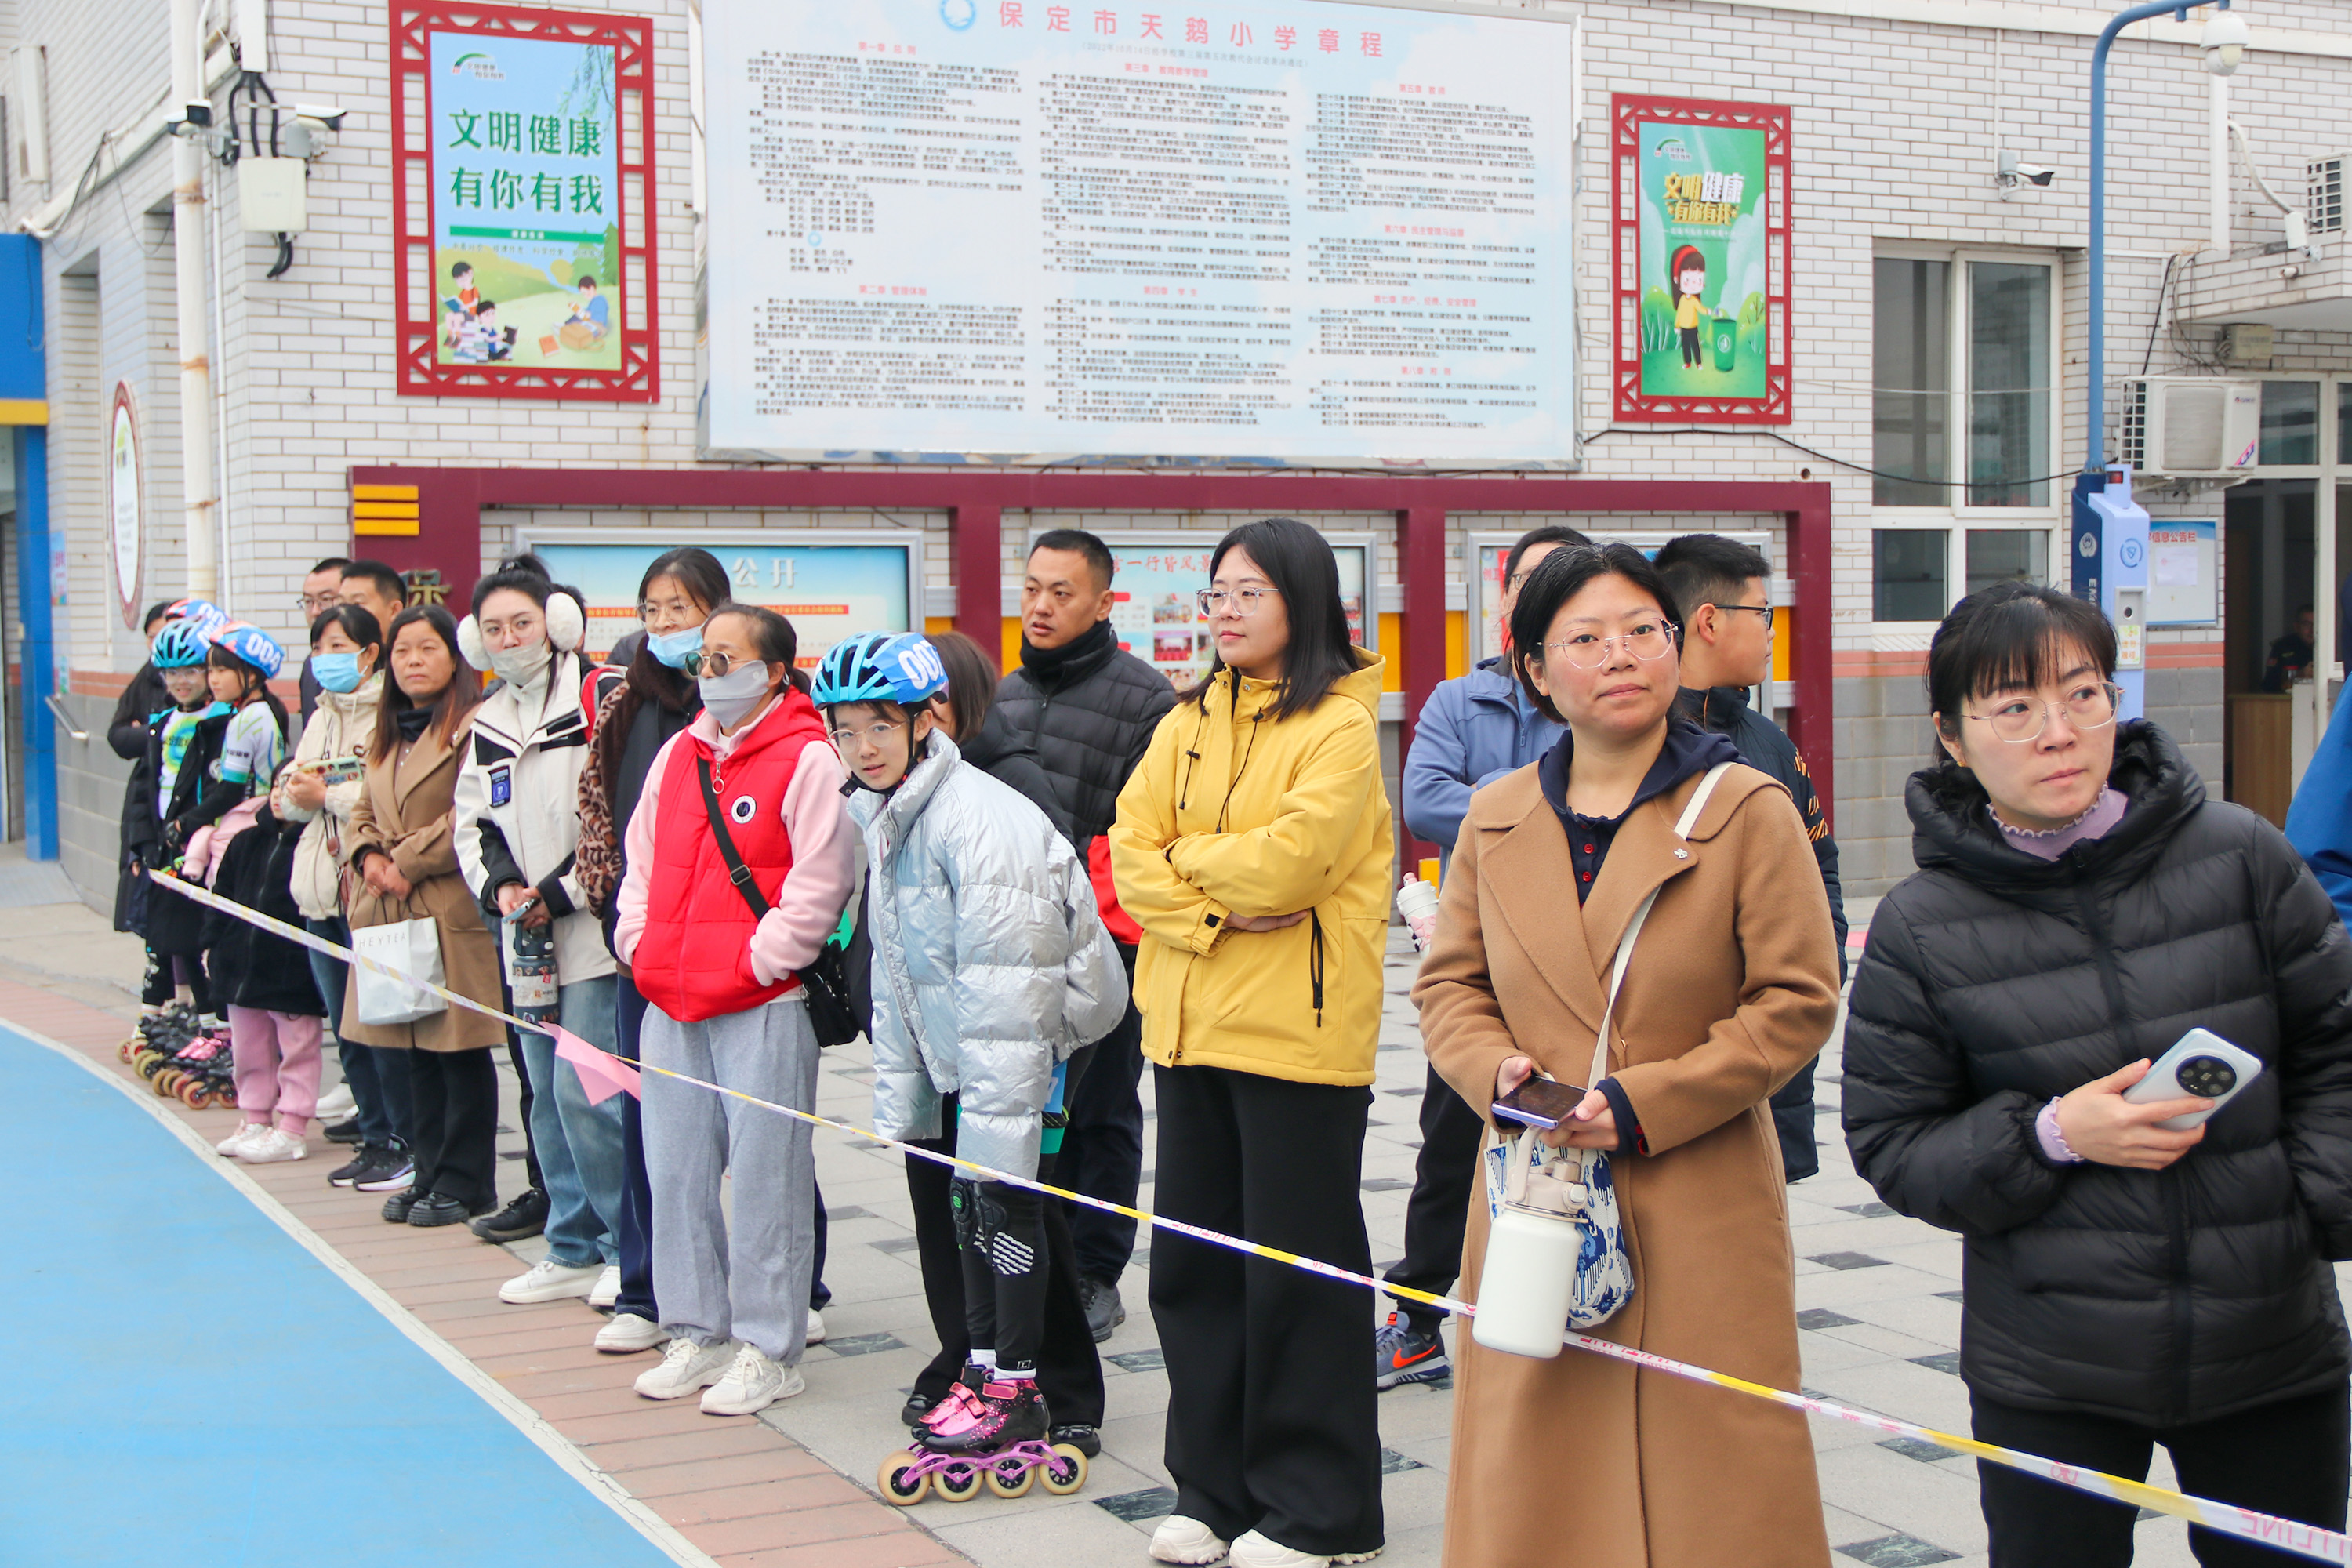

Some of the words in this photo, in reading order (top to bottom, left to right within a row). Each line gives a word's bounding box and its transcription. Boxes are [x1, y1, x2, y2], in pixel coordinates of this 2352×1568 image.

[998, 1, 1384, 58] 保定市天鹅小学章程
[449, 108, 602, 157] 文明健康
[450, 166, 603, 216] 有你有我
[1662, 171, 1745, 204] 文明健康
[1671, 199, 1733, 226] 有你有我
[731, 557, 798, 589] 公开
[245, 632, 281, 673] 004
[359, 931, 407, 949] HEYTEA
